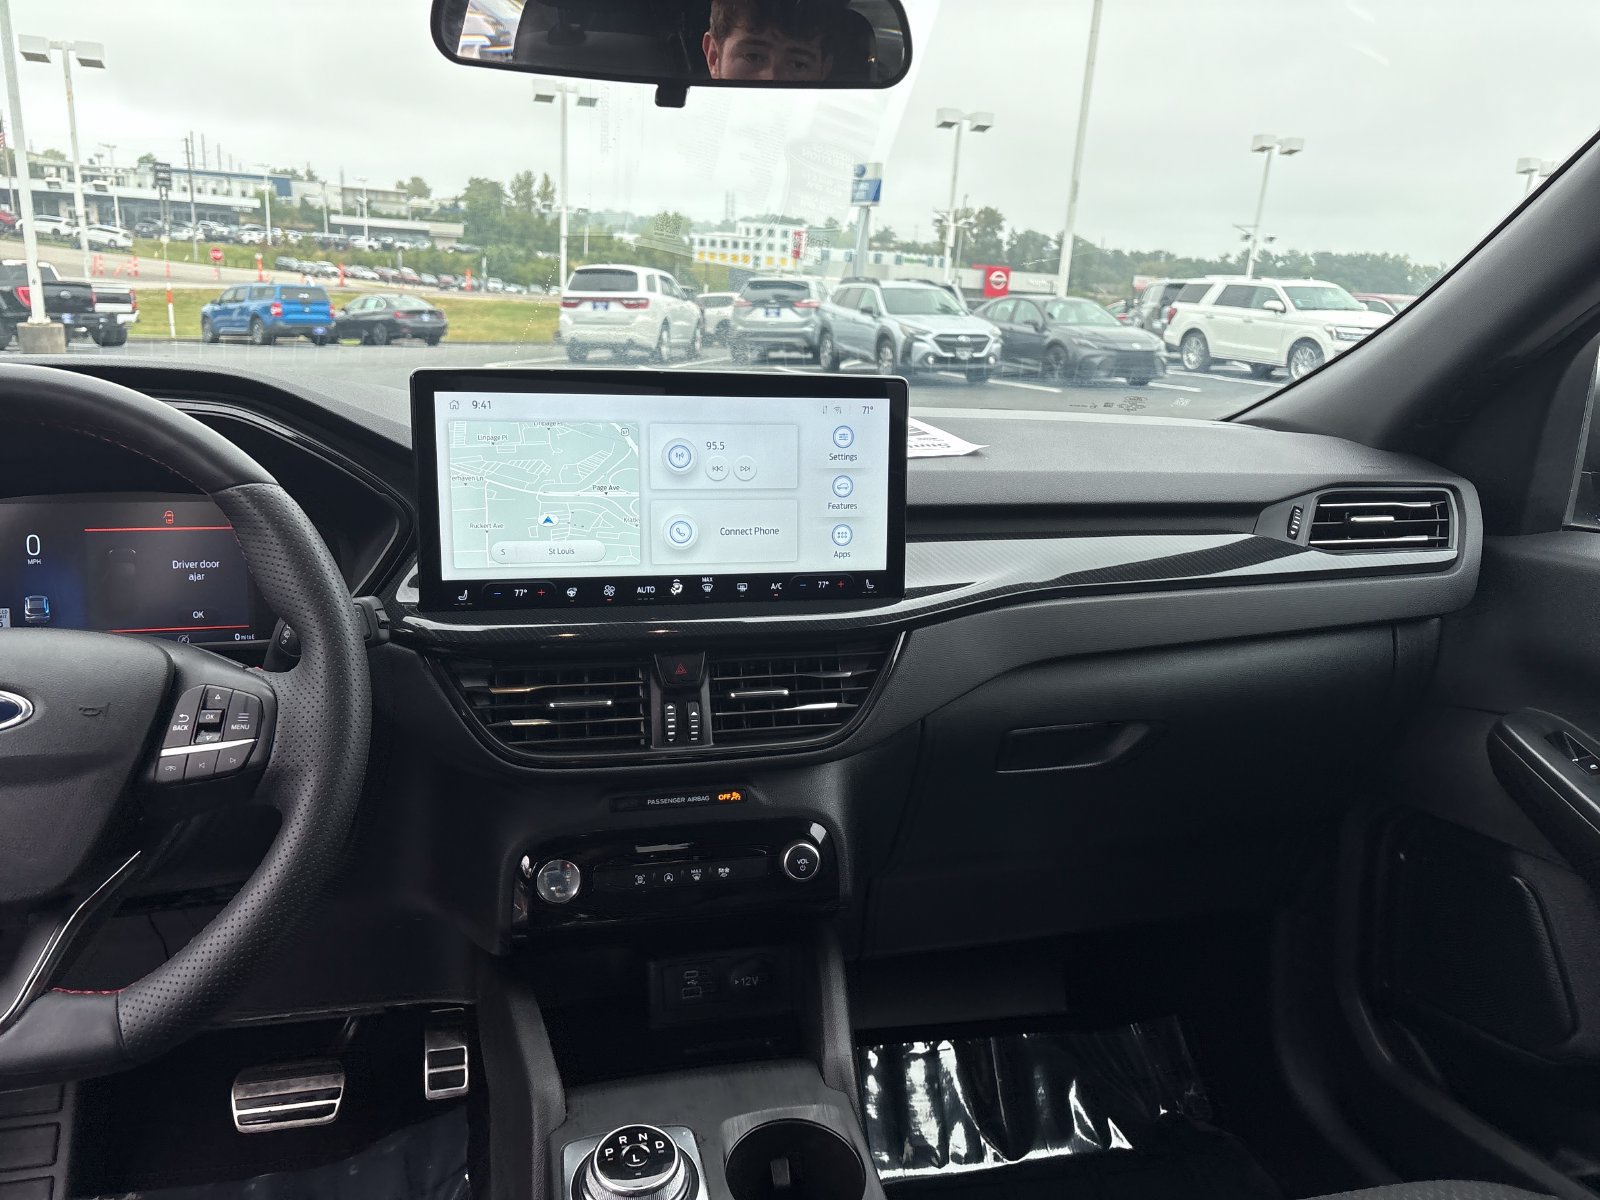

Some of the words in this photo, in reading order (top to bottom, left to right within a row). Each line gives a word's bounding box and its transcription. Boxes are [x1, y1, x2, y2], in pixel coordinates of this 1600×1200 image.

[471, 400, 492, 410] 9:41
[477, 434, 499, 442] Linpage
[706, 441, 725, 451] 95.5
[828, 452, 858, 462] Settings
[592, 484, 607, 492] Page
[827, 502, 858, 510] Features
[719, 526, 753, 536] Connect
[754, 526, 780, 536] Phone
[25, 534, 41, 556] 0
[501, 548, 506, 556] S
[548, 547, 556, 555] St
[557, 547, 575, 555] Louis
[833, 550, 851, 559] Apps
[172, 559, 198, 569] Driver
[199, 559, 220, 569] door
[188, 572, 205, 581] ajar
[770, 582, 783, 590] A/C
[817, 581, 830, 589] 77°
[514, 589, 528, 597] 77°
[636, 586, 656, 595] AUTO
[192, 611, 205, 619] OK
[234, 633, 241, 641] 0
[647, 797, 686, 805] PASSENGER
[717, 793, 731, 801] OFF
[741, 976, 759, 986] 12V
[604, 1147, 614, 1157] P
[618, 1135, 628, 1144] R
[638, 1132, 648, 1141] N
[655, 1140, 665, 1149] D
[632, 1153, 640, 1163] L
